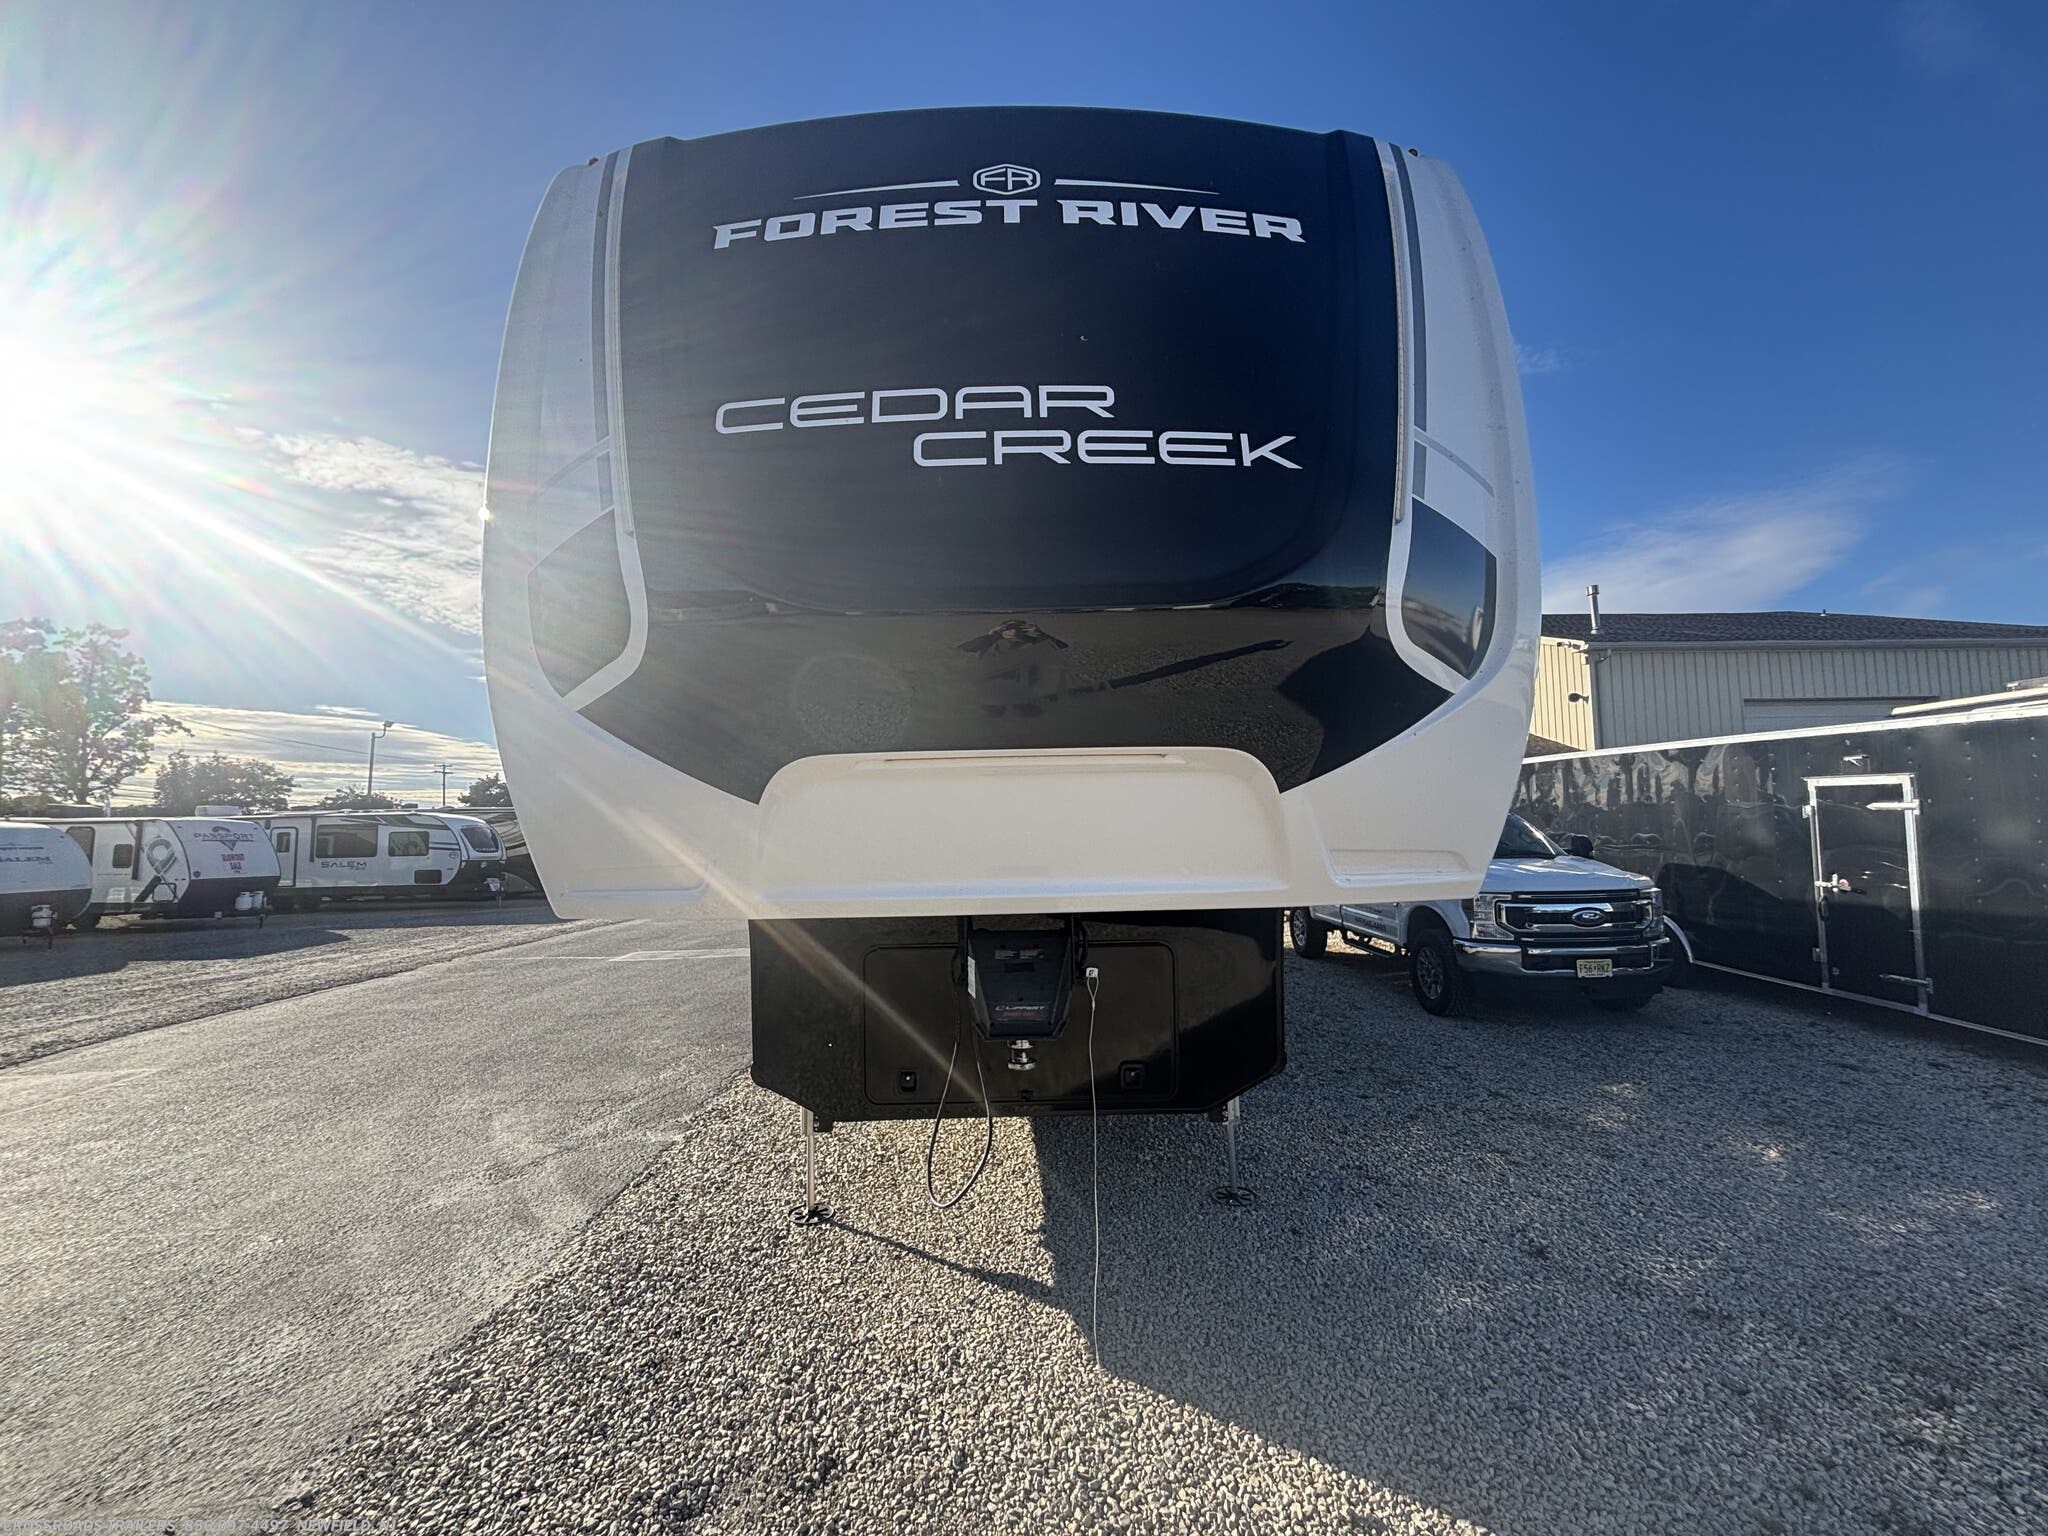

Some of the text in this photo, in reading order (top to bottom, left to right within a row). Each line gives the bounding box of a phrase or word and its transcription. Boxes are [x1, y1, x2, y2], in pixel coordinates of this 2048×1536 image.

[980, 167, 1034, 191] FR
[713, 200, 1306, 250] FOREST RIVER
[715, 385, 1115, 434] CEDAR
[913, 430, 1303, 470] CREEK
[193, 832, 255, 840] PASSPORT
[320, 861, 367, 869] SALEM
